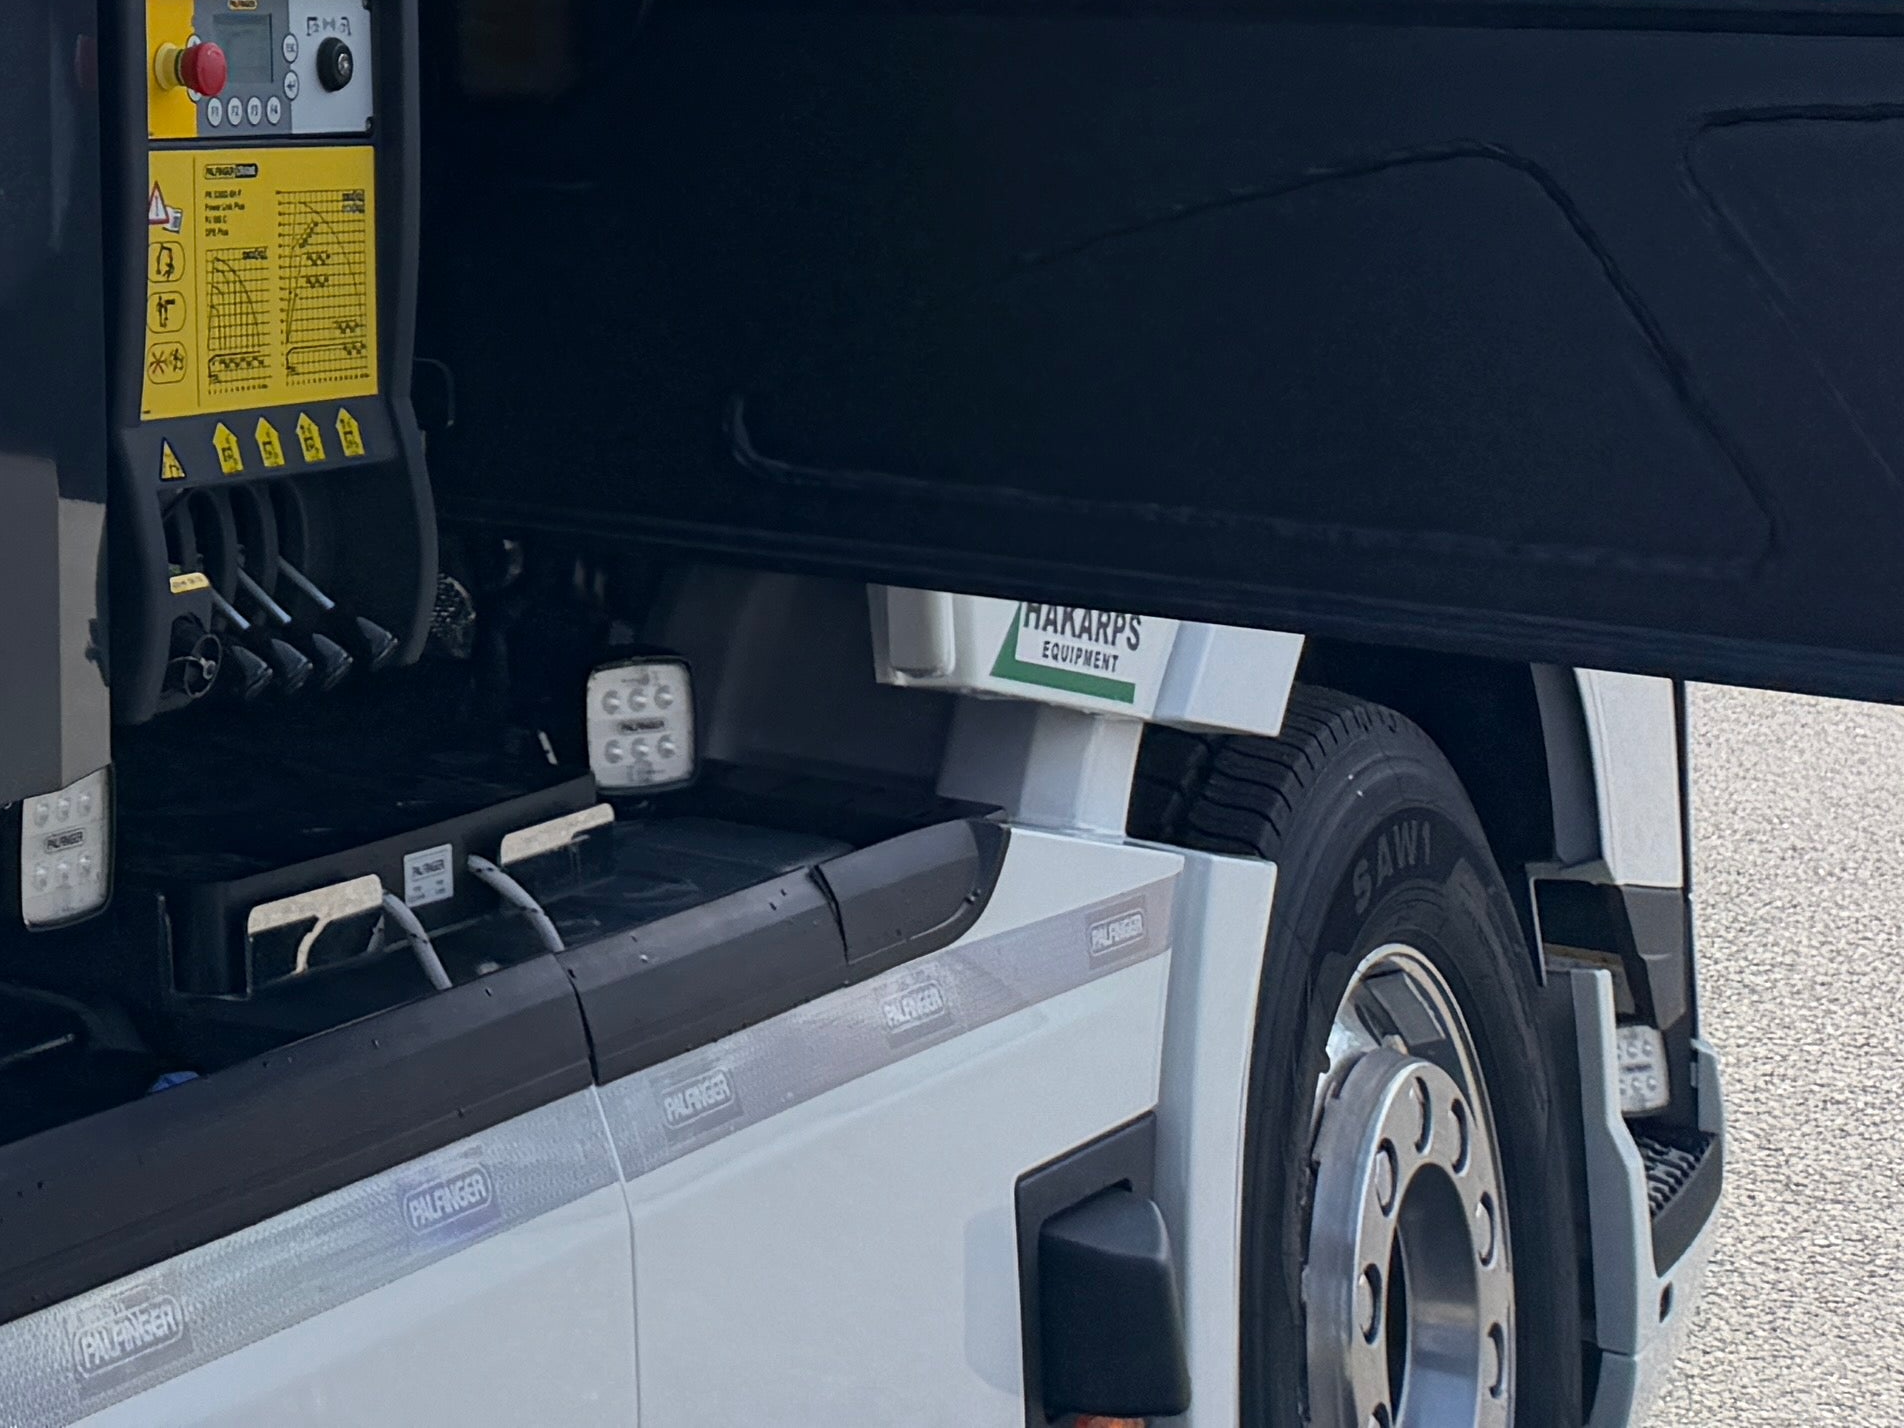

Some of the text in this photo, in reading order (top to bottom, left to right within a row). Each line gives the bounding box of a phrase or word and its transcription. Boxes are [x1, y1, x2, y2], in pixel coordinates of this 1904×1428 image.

[1042, 640, 1119, 673] EQUIPMENT
[883, 985, 944, 1029] PALFINGER
[662, 1070, 732, 1124] PALFINGER
[408, 1173, 489, 1230] PALFINGER
[81, 1302, 177, 1370] PALFINGER
